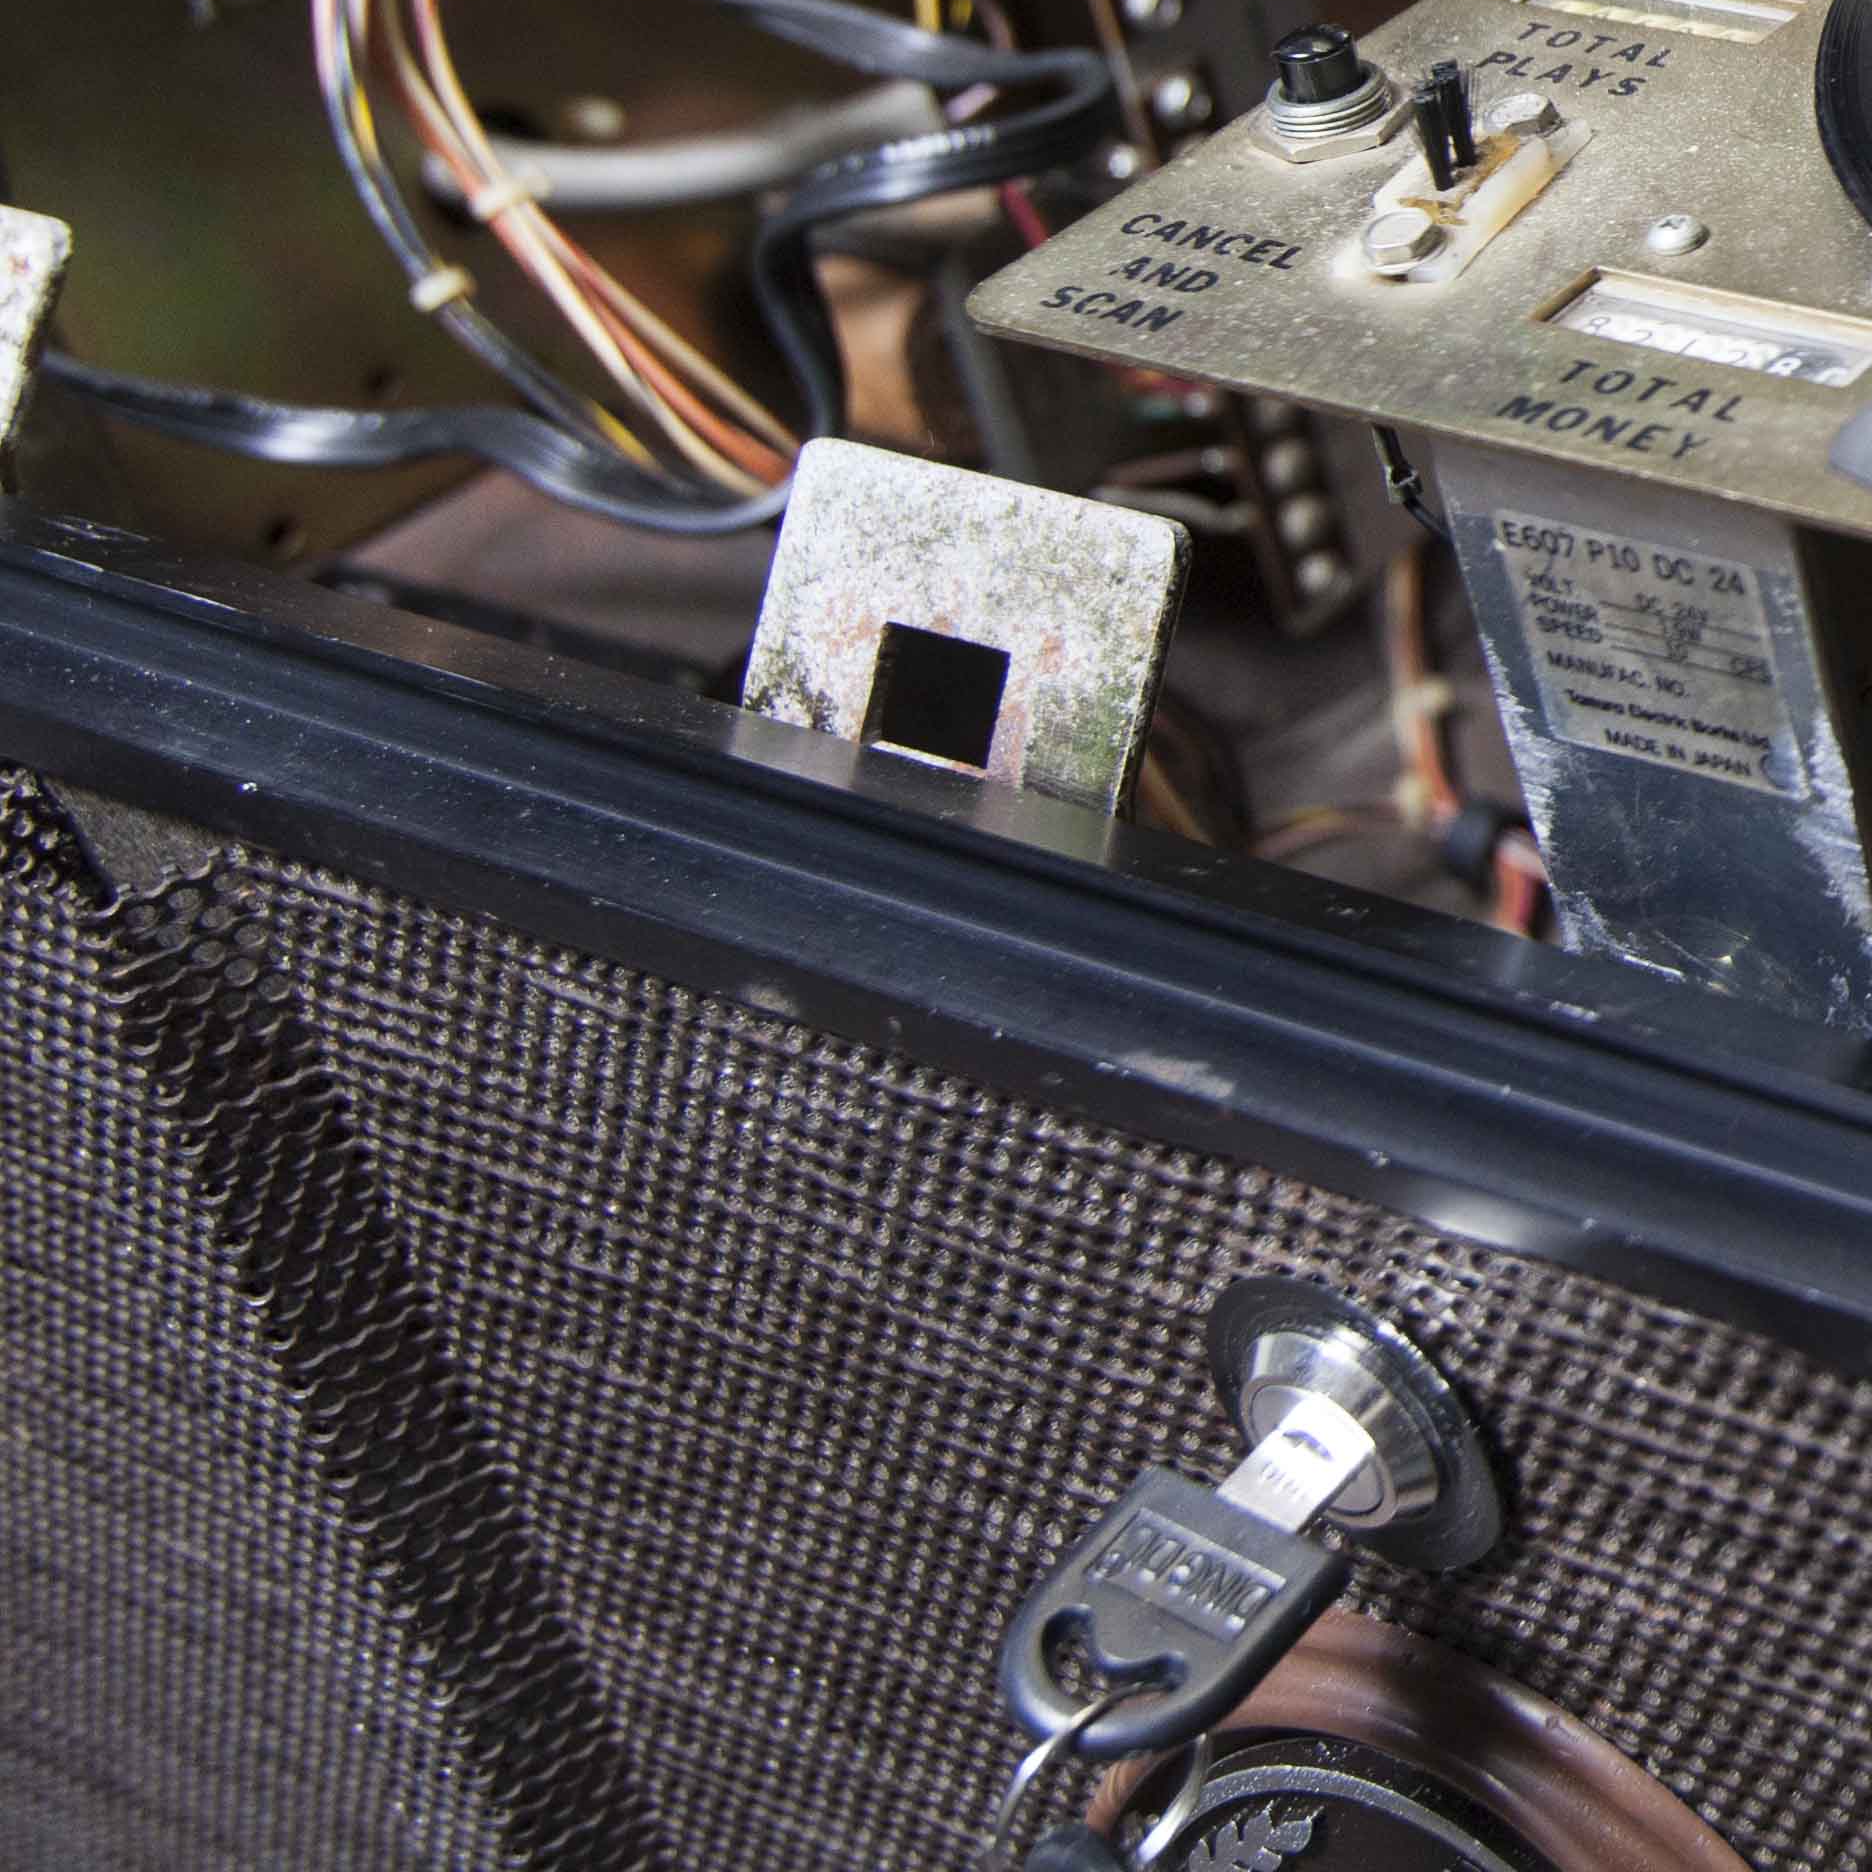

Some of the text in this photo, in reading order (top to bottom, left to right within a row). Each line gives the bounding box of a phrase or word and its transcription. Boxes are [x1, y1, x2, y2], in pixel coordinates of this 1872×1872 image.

[1517, 21, 1672, 69] TOTAL
[1475, 50, 1648, 97] PLAYS
[1119, 213, 1303, 270] CANCEL
[1108, 255, 1220, 293] AND
[1039, 285, 1185, 332] SCAN
[1560, 358, 1746, 423] TOTAL
[1497, 394, 1709, 459] MONEY
[1500, 519, 1575, 559] E607
[1586, 537, 1641, 574] P10
[1651, 551, 1696, 587] DC
[1535, 615, 1603, 645] SPEED
[1655, 675, 1692, 698] NO.
[1603, 727, 1662, 758] MADE
[1693, 749, 1752, 777] JAPAN
